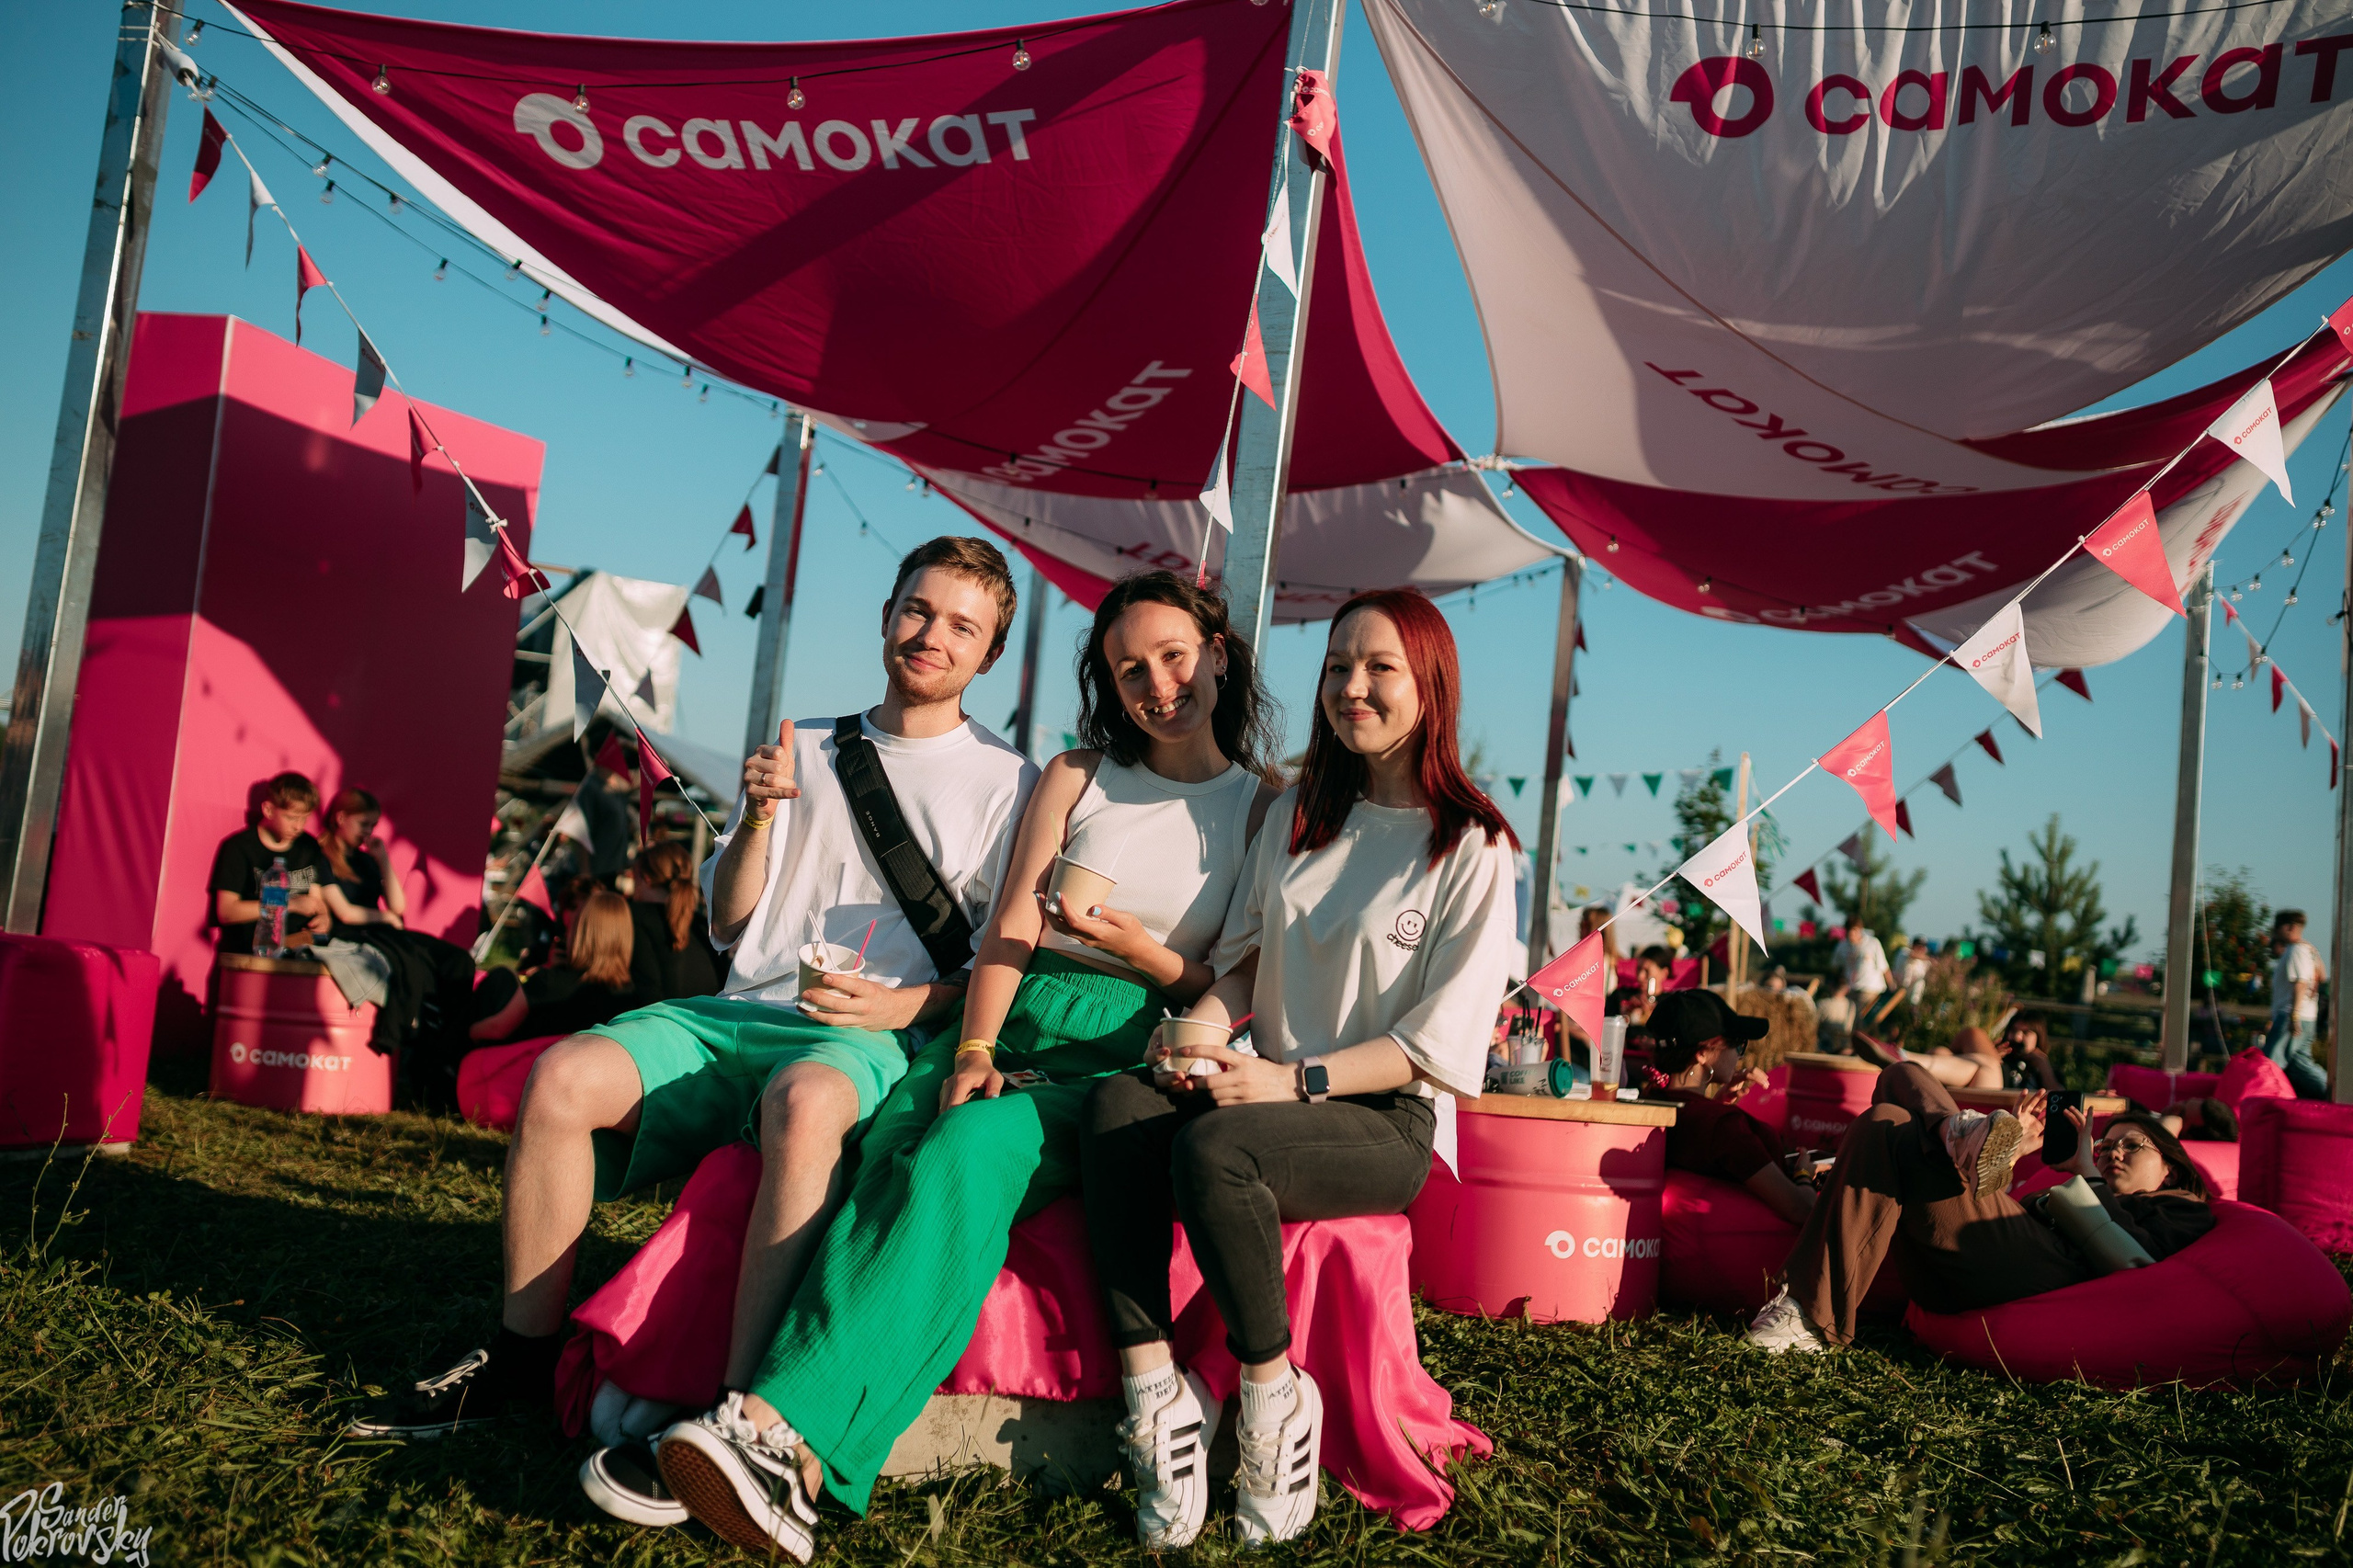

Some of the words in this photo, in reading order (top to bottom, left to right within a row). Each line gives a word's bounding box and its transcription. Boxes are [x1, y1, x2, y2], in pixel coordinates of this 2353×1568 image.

[1804, 34, 2353, 136] самокат
[622, 108, 1037, 171] самокат
[2241, 406, 2273, 439] самокат
[2111, 517, 2150, 551] самокат
[1982, 631, 2021, 662] самокат
[1855, 740, 1885, 771] самокат
[865, 810, 881, 838] BANGE
[1713, 850, 1747, 881] самокат
[1563, 961, 1600, 992] самокат
[248, 1048, 352, 1072] самокат
